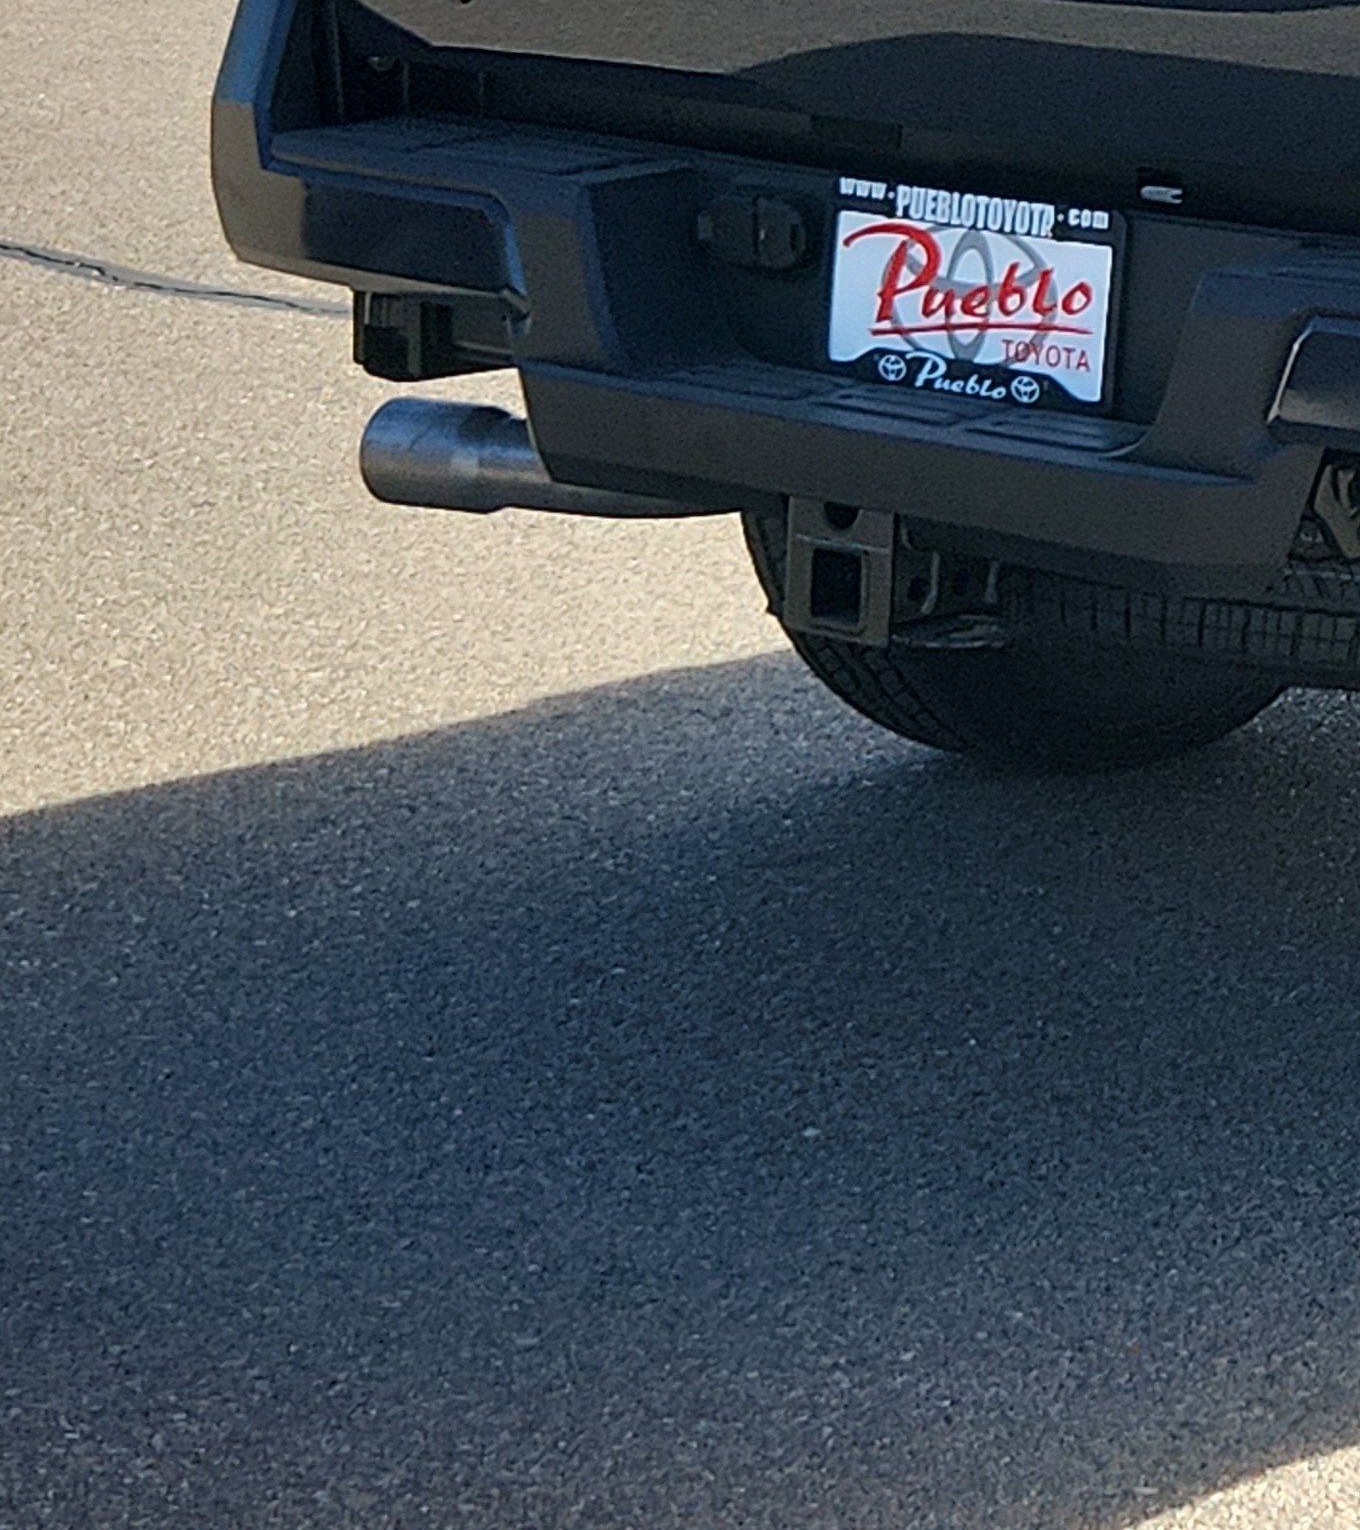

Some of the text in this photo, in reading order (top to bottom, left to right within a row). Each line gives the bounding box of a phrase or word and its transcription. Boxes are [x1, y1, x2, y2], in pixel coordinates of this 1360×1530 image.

[842, 222, 1093, 323] Pueblo
[904, 350, 1007, 400] Pueblo
[1001, 338, 1092, 373] TOYOTA
